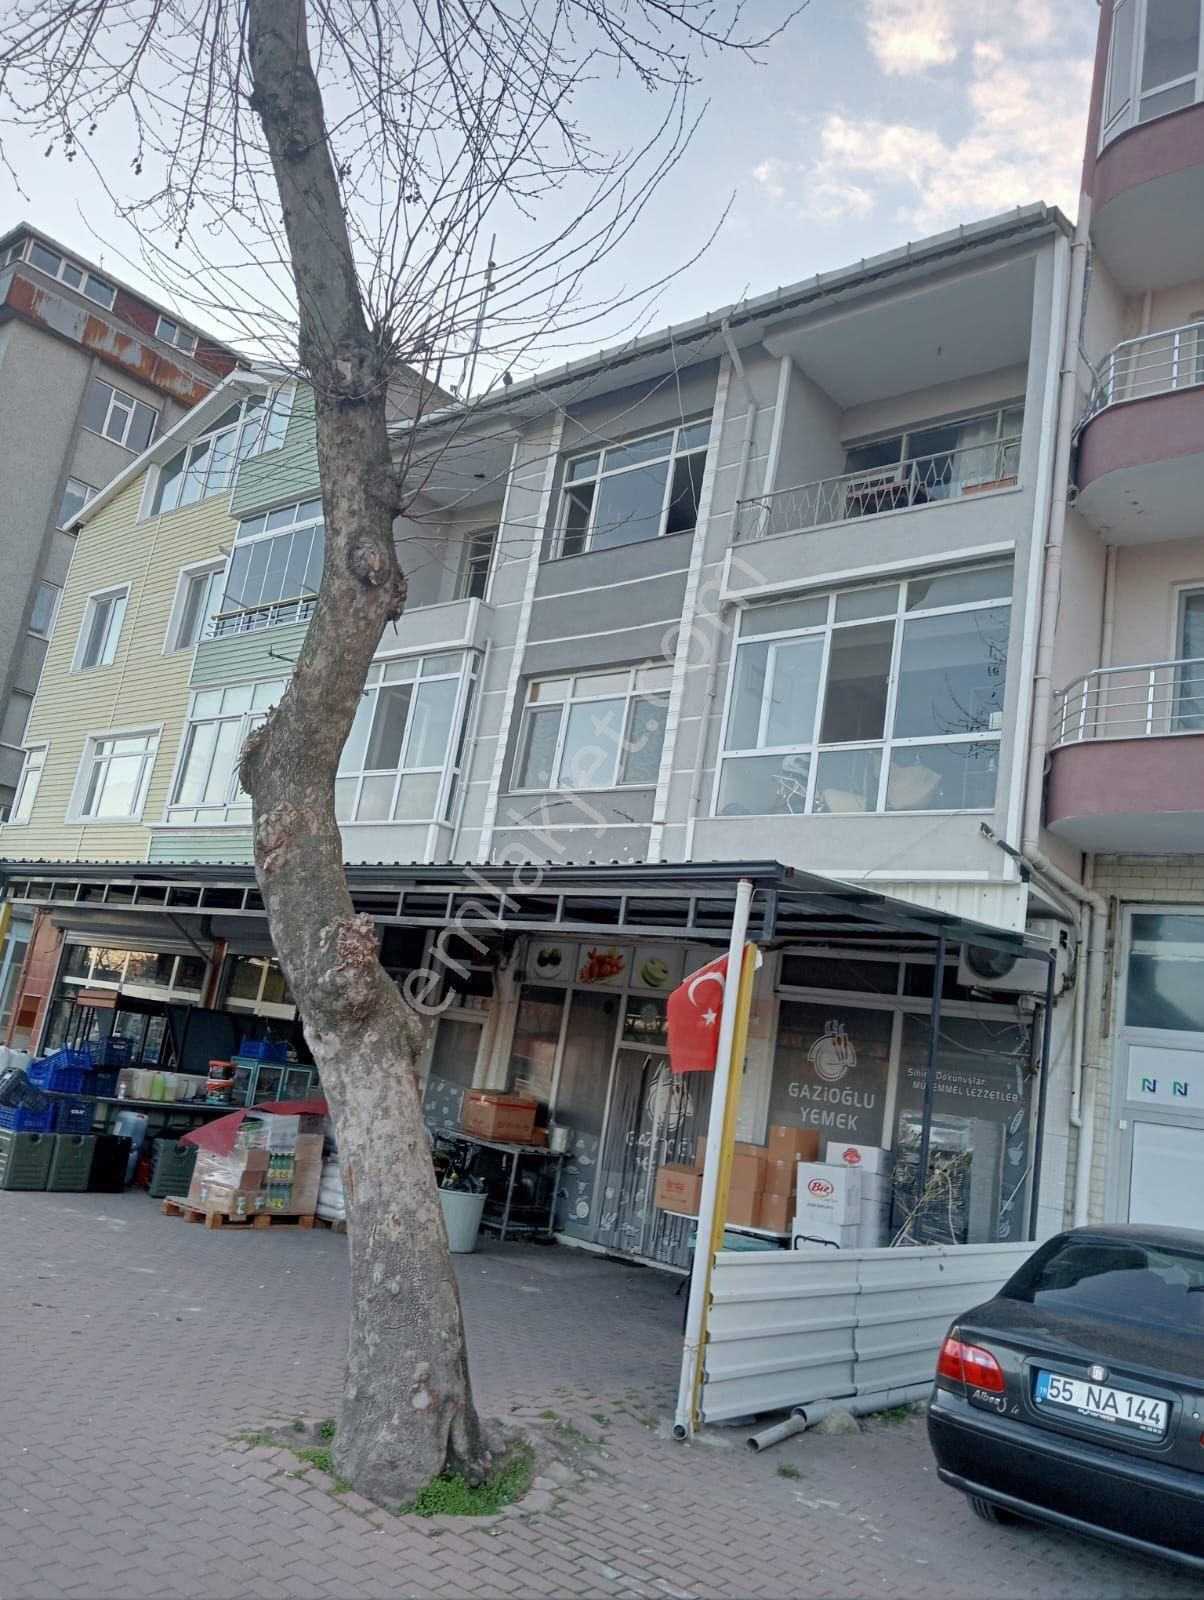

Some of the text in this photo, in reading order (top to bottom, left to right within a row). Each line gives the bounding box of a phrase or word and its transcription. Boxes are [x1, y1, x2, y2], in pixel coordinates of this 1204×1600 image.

[912, 1080, 963, 1096] MÜEMMEL
[800, 1106, 859, 1131] YEMEK
[1049, 1377, 1161, 1425] 55 NA 144
